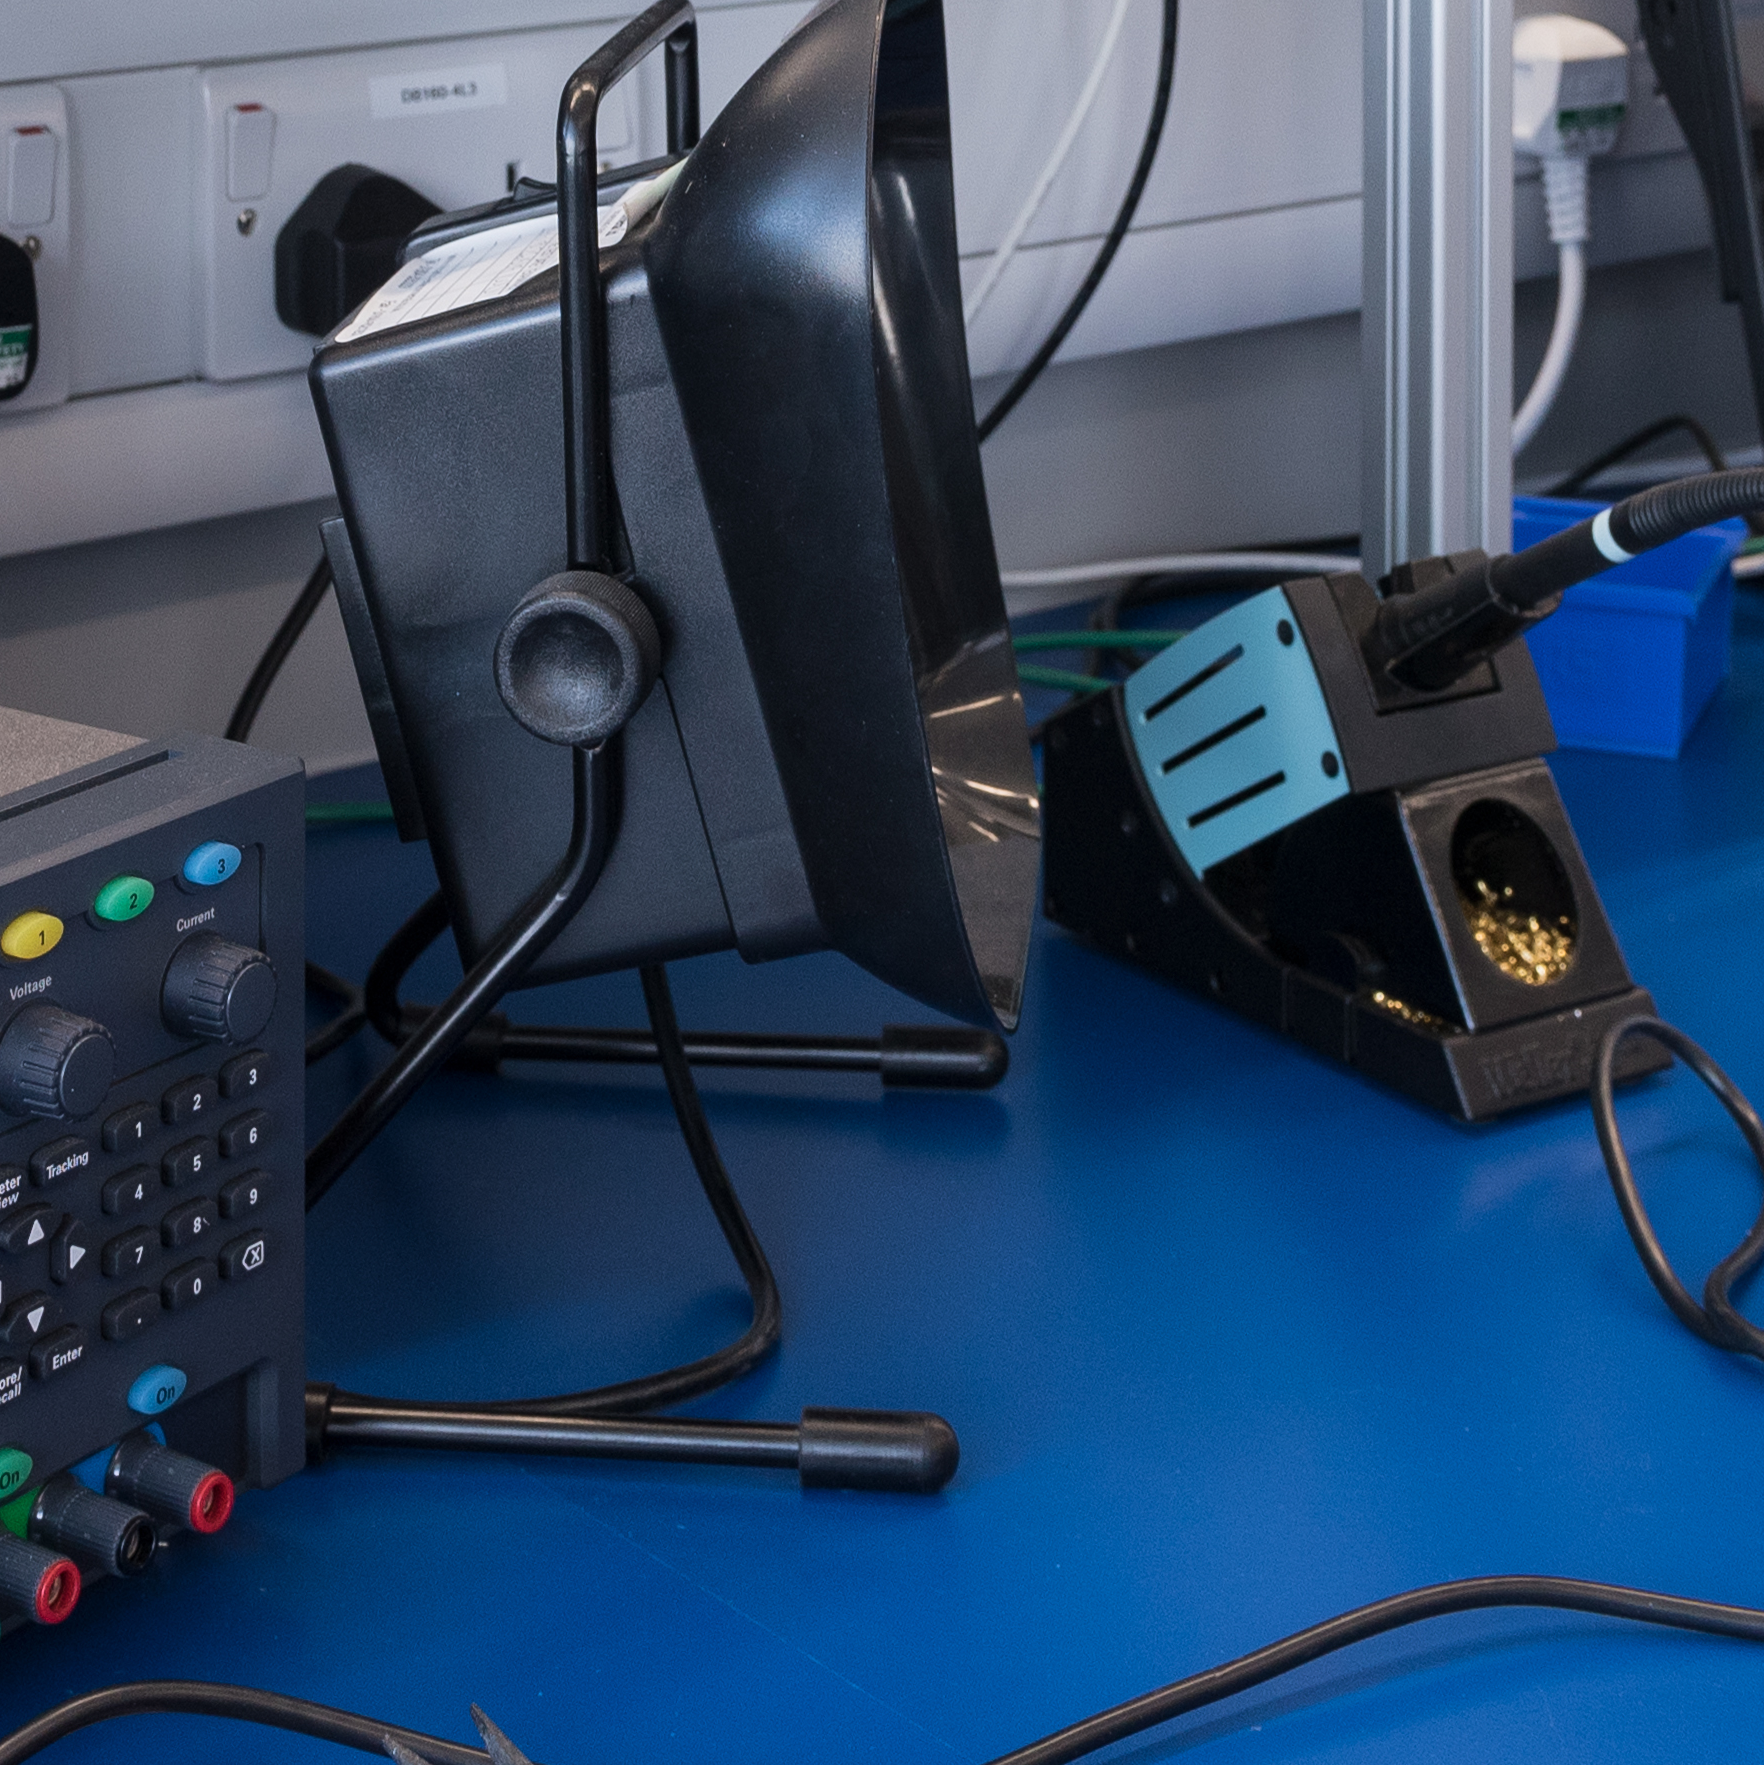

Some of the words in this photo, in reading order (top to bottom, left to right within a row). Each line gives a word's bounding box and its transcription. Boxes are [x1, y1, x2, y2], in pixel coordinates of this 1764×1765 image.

[218, 858, 226, 874] 3
[129, 893, 138, 910] 2
[176, 907, 215, 933] Current
[38, 930, 45, 946] 1
[9, 975, 52, 1001] Voltage
[249, 1068, 258, 1085] 3
[193, 1094, 202, 1111] 2
[135, 1121, 142, 1138] 1
[249, 1127, 258, 1144] 6
[46, 1151, 89, 1180] Tracking
[192, 1154, 202, 1172] 5
[134, 1184, 143, 1200] 4
[249, 1188, 258, 1205] 9
[193, 1216, 202, 1234] 8
[135, 1245, 144, 1264] 7
[193, 1278, 202, 1295] 0
[52, 1344, 83, 1371] Enter
[156, 1385, 176, 1405] On
